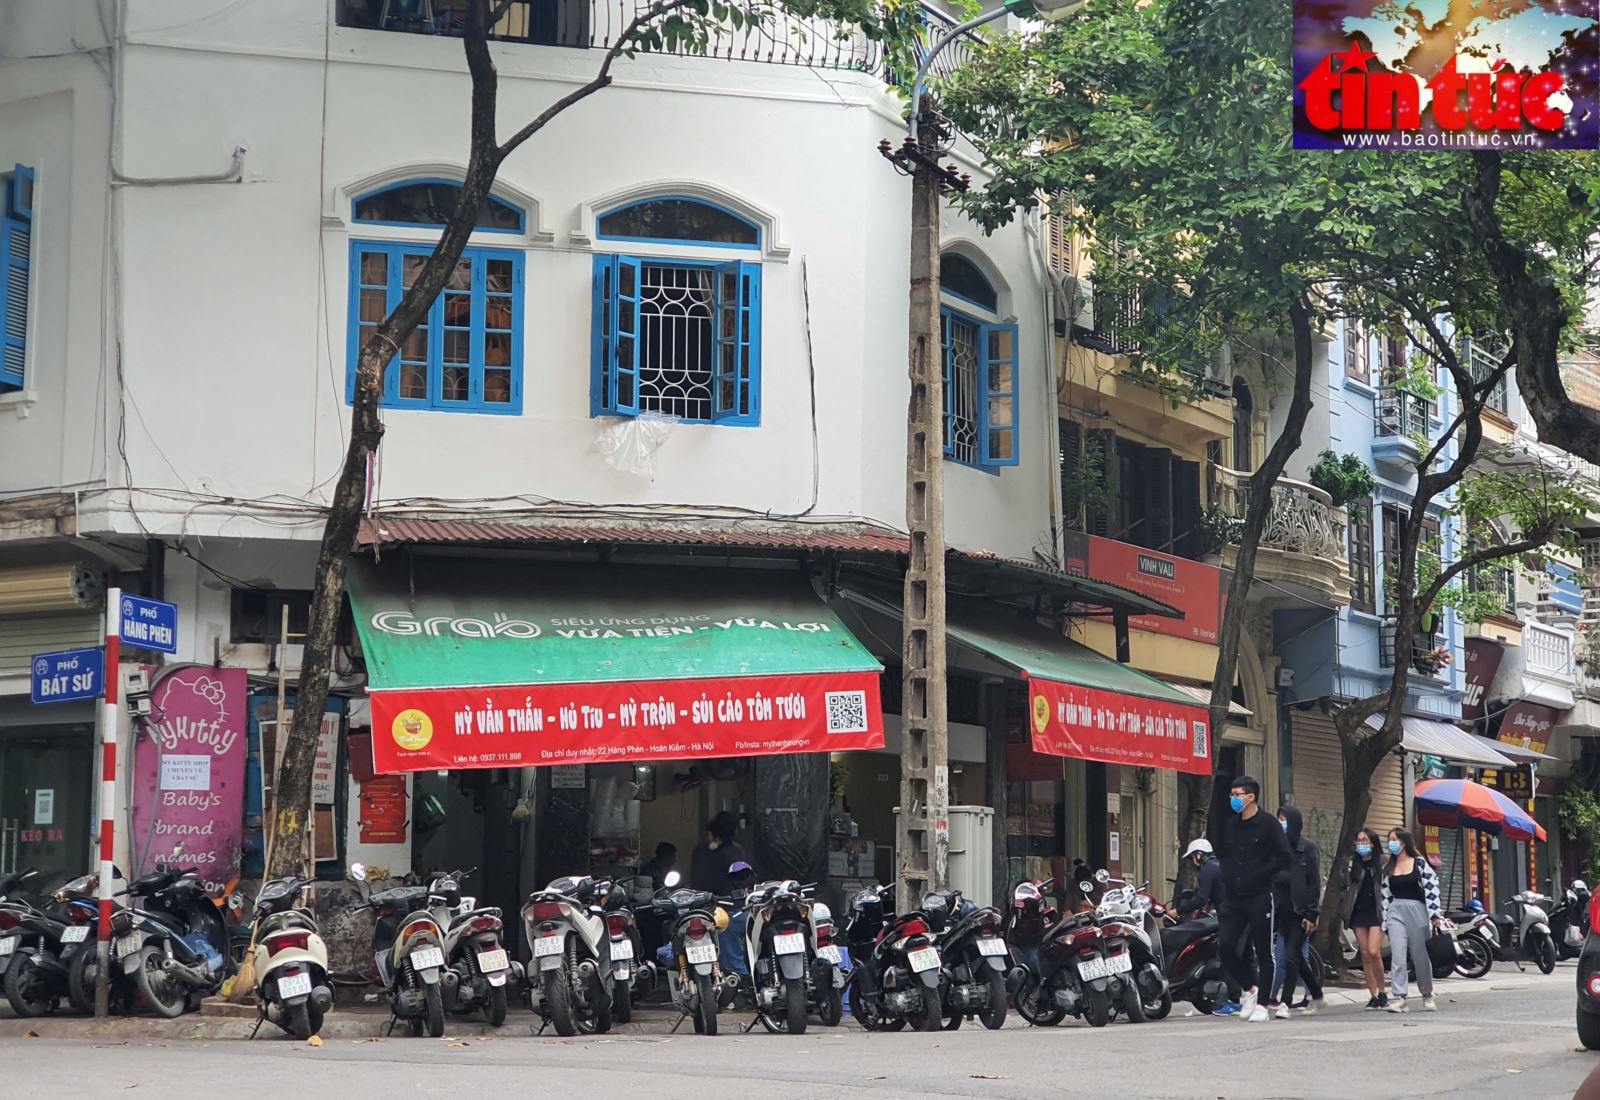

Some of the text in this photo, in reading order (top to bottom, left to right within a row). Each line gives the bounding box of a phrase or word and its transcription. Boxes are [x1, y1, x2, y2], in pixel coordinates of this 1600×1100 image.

[1139, 557, 1156, 573] VINH
[140, 606, 158, 619] PHỐ
[550, 616, 594, 626] SIÊU
[650, 614, 711, 625] DỤNG
[124, 617, 172, 644] HÀNG PHÈN
[371, 611, 541, 639] Grab
[555, 627, 623, 639] VỪA
[626, 625, 694, 638] TIỆN
[713, 616, 780, 630] VỪA
[782, 622, 831, 633] LỢI
[57, 656, 79, 671] PHỐ
[40, 667, 95, 696] BÁT SỨ
[454, 704, 473, 735] MỲ
[476, 697, 504, 734] VẰN
[507, 696, 543, 733] THẮN
[559, 701, 578, 730] HỦ
[620, 697, 637, 727] MỲ
[641, 696, 676, 730] TRỘN
[692, 692, 714, 724] SỦI
[717, 691, 743, 722] CẢO
[746, 691, 772, 721] TÔM
[775, 692, 806, 719] TƯƠI
[566, 746, 578, 757] duy
[597, 746, 606, 755] 22
[607, 745, 626, 755] Hàng
[650, 742, 668, 752] Hoàn
[691, 742, 702, 750] Hà
[702, 740, 714, 751] Nội
[453, 754, 468, 763] Liên
[162, 790, 221, 811] Baby's
[154, 819, 214, 835] brand
[154, 850, 217, 864] names
